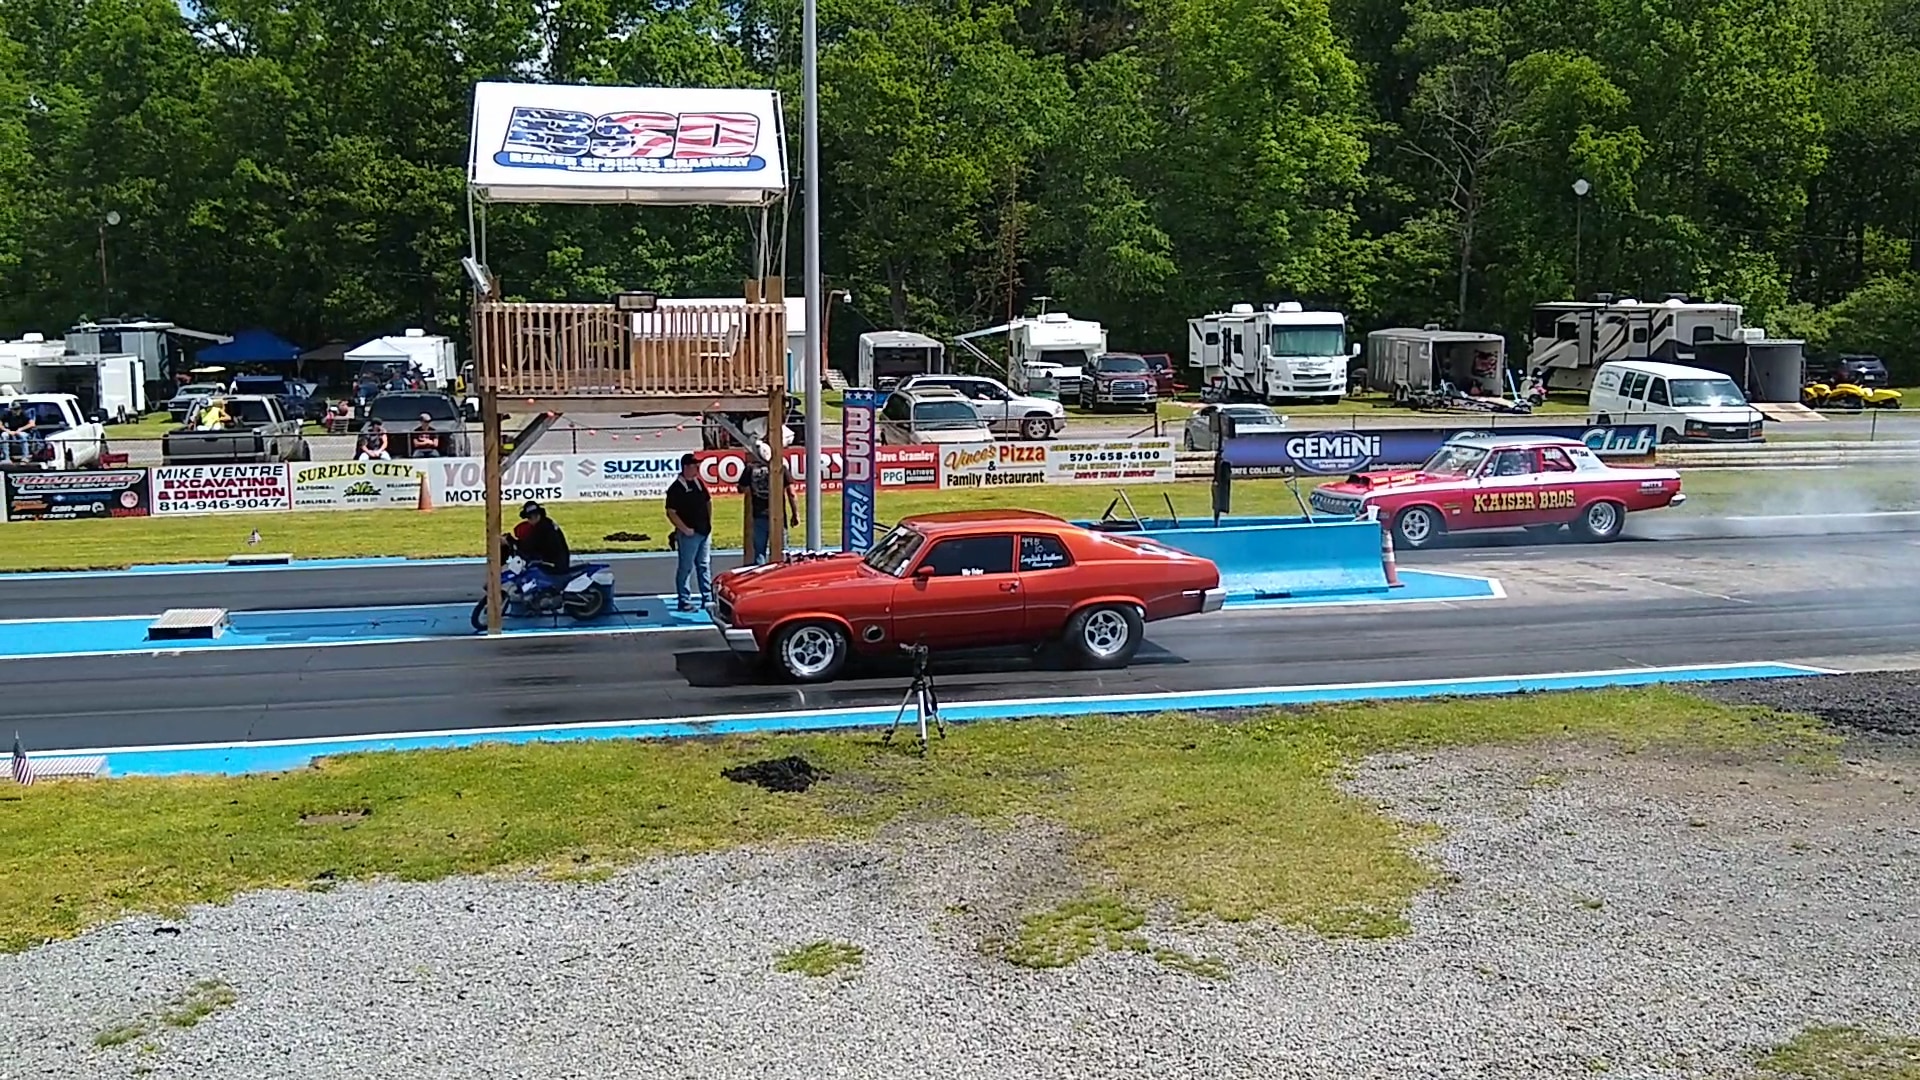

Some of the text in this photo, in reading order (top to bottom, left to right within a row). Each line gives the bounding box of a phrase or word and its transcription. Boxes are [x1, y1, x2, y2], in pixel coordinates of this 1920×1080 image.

[509, 152, 750, 168] BEAVER SPRINGS DRAGWAY
[875, 450, 935, 462] Dave Gramley
[944, 445, 1046, 470] Vince's Pizza
[1069, 451, 1160, 461] 570-658-6100
[156, 465, 284, 480] MIKE VENTRE
[603, 459, 680, 473] SUZUKI
[987, 461, 996, 470] &
[297, 463, 366, 483] SURPLUS
[372, 463, 413, 477] CITY
[443, 460, 564, 487] YOUM'S
[883, 471, 903, 482] PPG
[947, 471, 1045, 487] Family Restaurant
[164, 477, 278, 489] EXCAVATING
[158, 487, 286, 500] & DEMOLITION
[445, 487, 562, 502] MOTSPORTS
[159, 498, 281, 511] 814-946-9047
[1473, 489, 1576, 513] KAISER BROS.
[111, 508, 147, 517] YAMAHA
